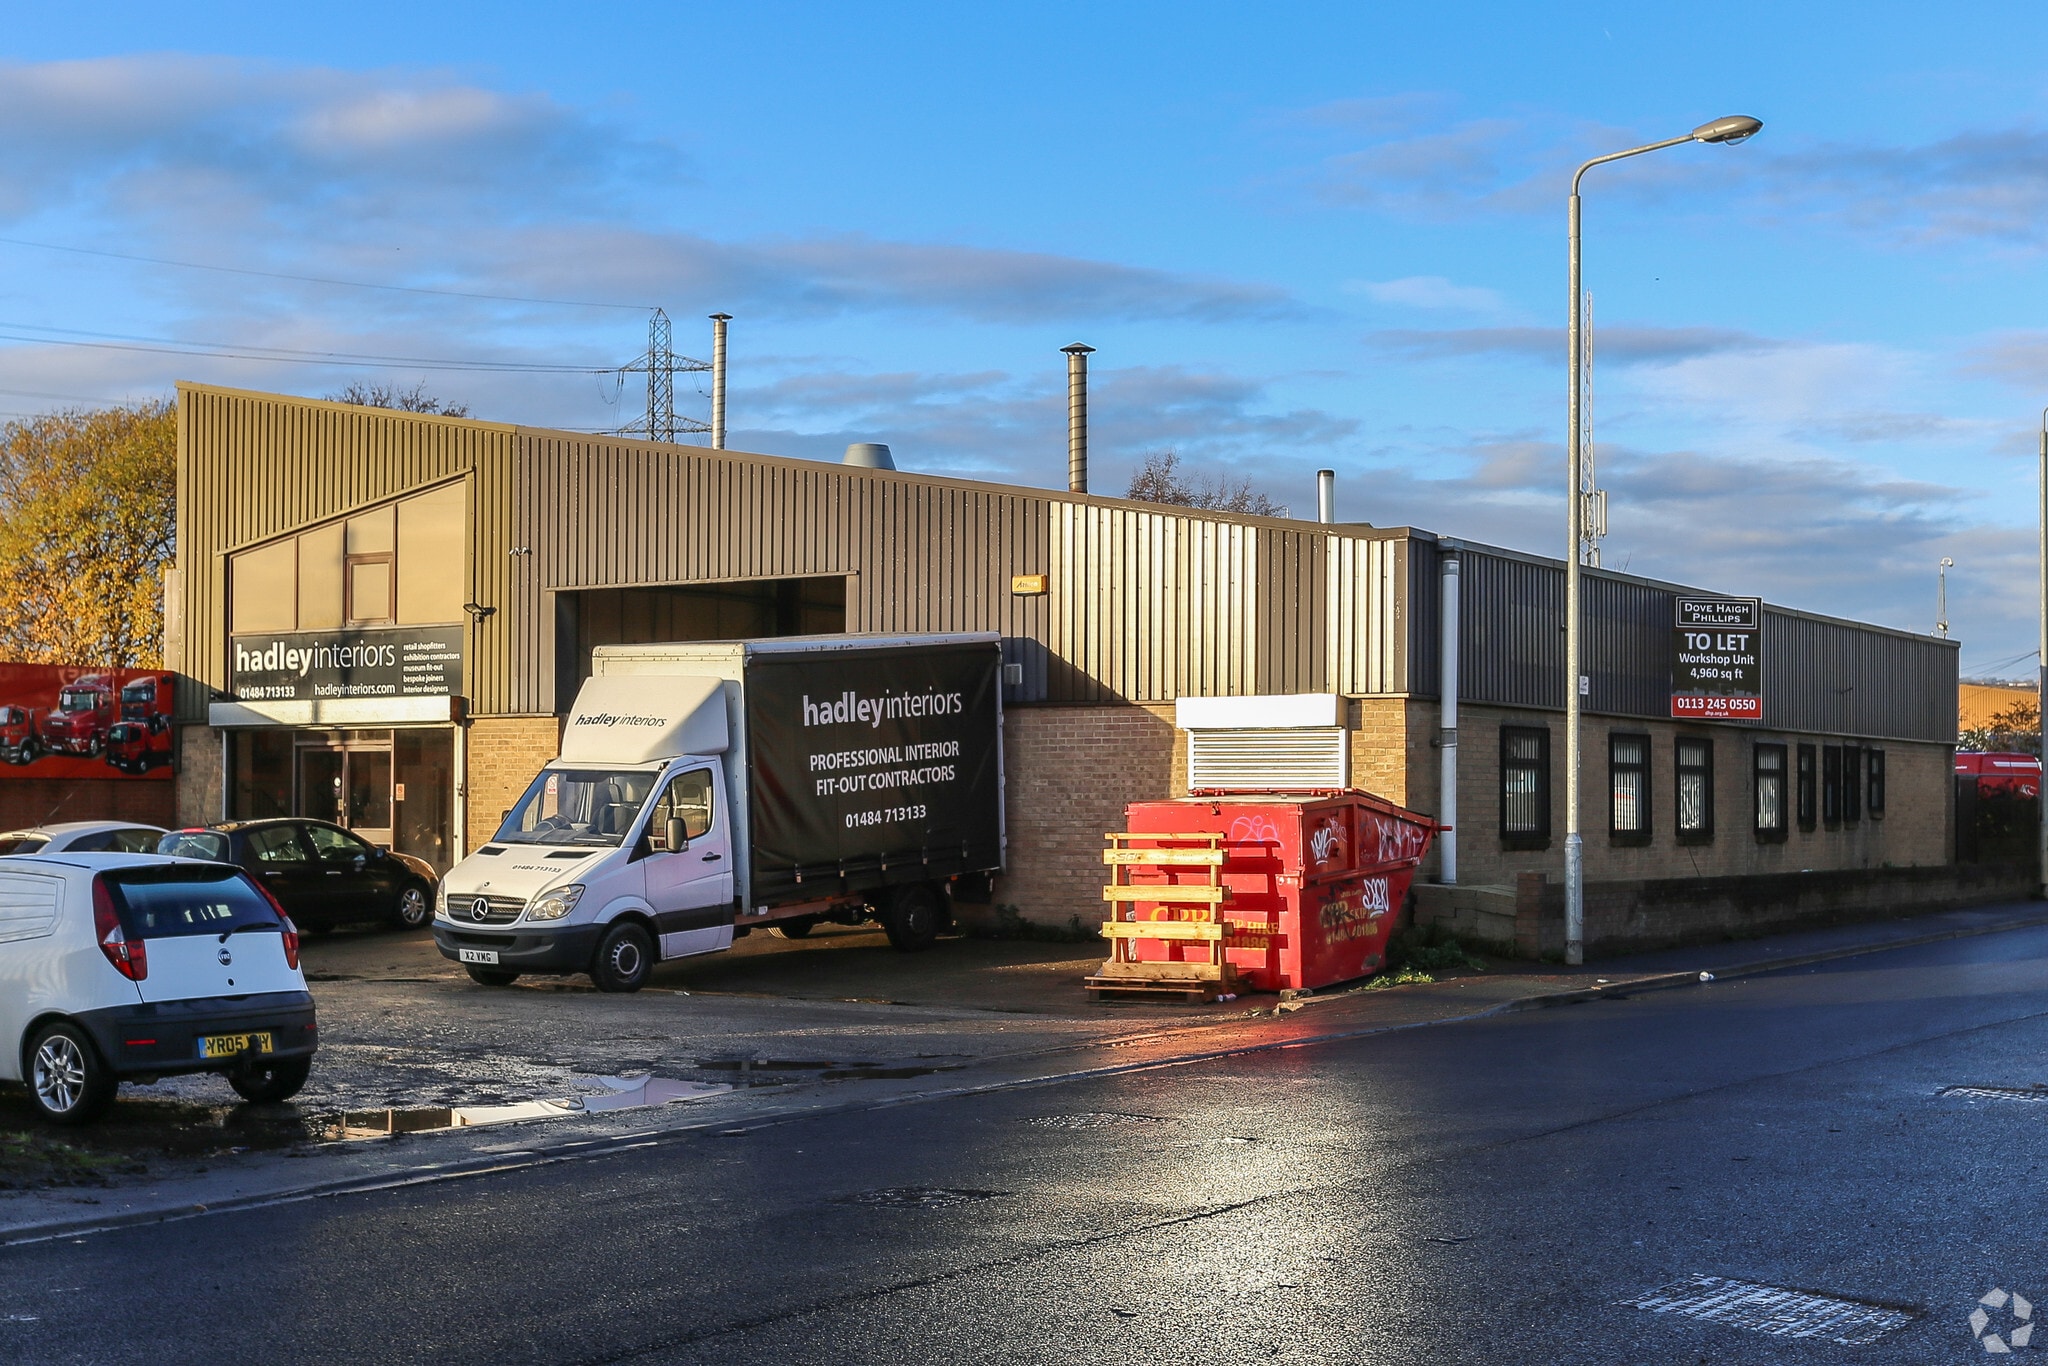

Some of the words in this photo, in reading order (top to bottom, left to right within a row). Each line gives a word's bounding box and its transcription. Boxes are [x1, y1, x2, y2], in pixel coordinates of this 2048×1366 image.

[1684, 603, 1713, 613] DOVE
[1716, 604, 1749, 614] HAIGH
[1692, 613, 1741, 623] PHILLIPS
[403, 642, 417, 651] retail
[417, 641, 446, 651] shopfitters
[1684, 632, 1711, 650] TO
[1716, 634, 1749, 651] LET
[403, 653, 430, 662] exhibition
[430, 652, 460, 660] contractors
[1679, 653, 1730, 666] Workshop
[1732, 654, 1754, 665] Unit
[426, 663, 444, 671] fit-out
[403, 674, 426, 684] bespoke
[425, 674, 444, 684] joiners
[1690, 668, 1719, 679] 4,960
[1720, 670, 1732, 681] sq
[1734, 668, 1743, 679] ft
[240, 686, 264, 699] 01484
[265, 685, 295, 698] 713133
[314, 682, 396, 697] hadleyinteriors.com
[423, 685, 449, 695] designers
[1677, 698, 1704, 709] 0113
[1707, 698, 1727, 709] 245
[1729, 699, 1756, 710] 0550
[810, 746, 903, 771] PROFESSIONAL
[905, 740, 960, 762] INTERIOR
[816, 774, 867, 796] FIT-OUT
[868, 764, 956, 790] CONTRACTORS
[845, 810, 882, 828] 01484
[884, 804, 927, 823] 713133
